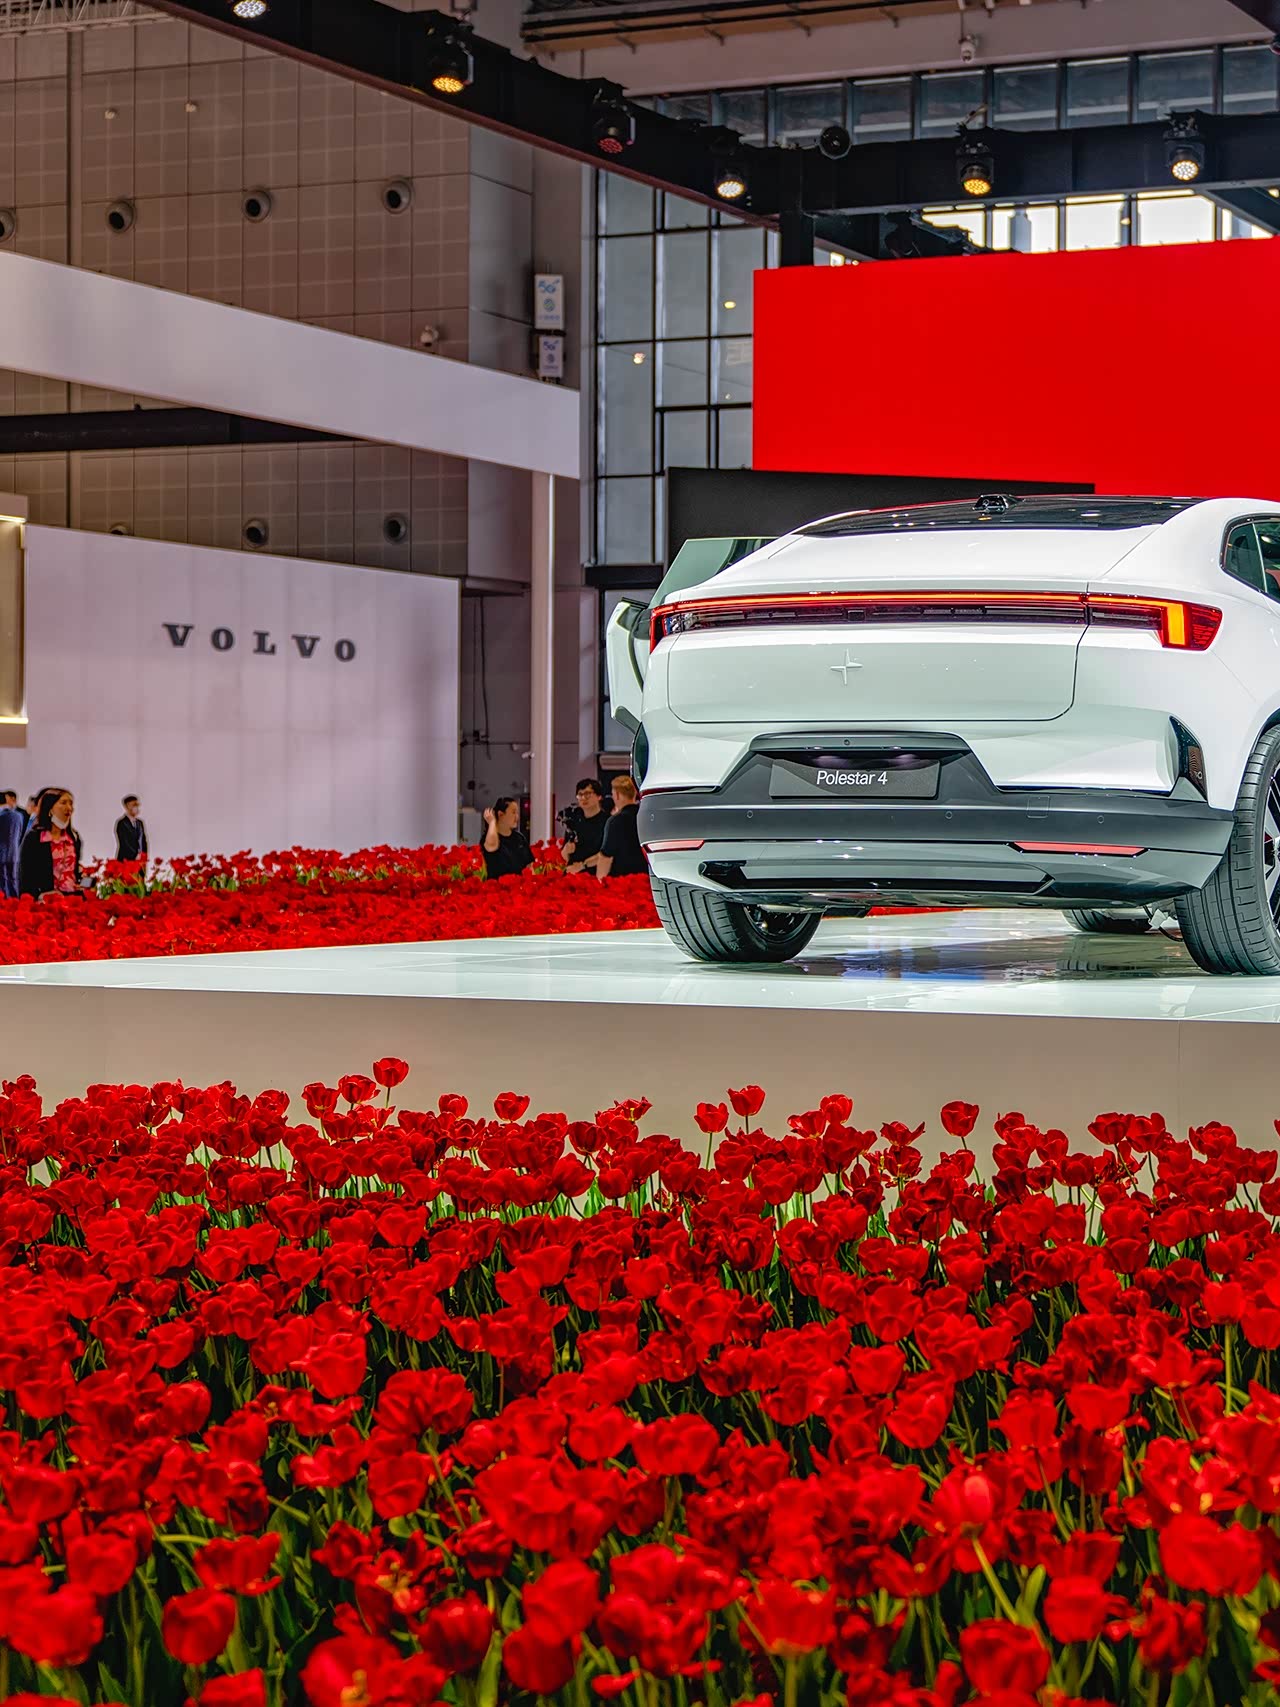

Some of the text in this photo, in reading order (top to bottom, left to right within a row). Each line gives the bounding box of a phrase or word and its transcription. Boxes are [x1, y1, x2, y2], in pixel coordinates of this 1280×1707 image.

[162, 622, 357, 663] VOLVO
[816, 770, 888, 785] Polestar 4
